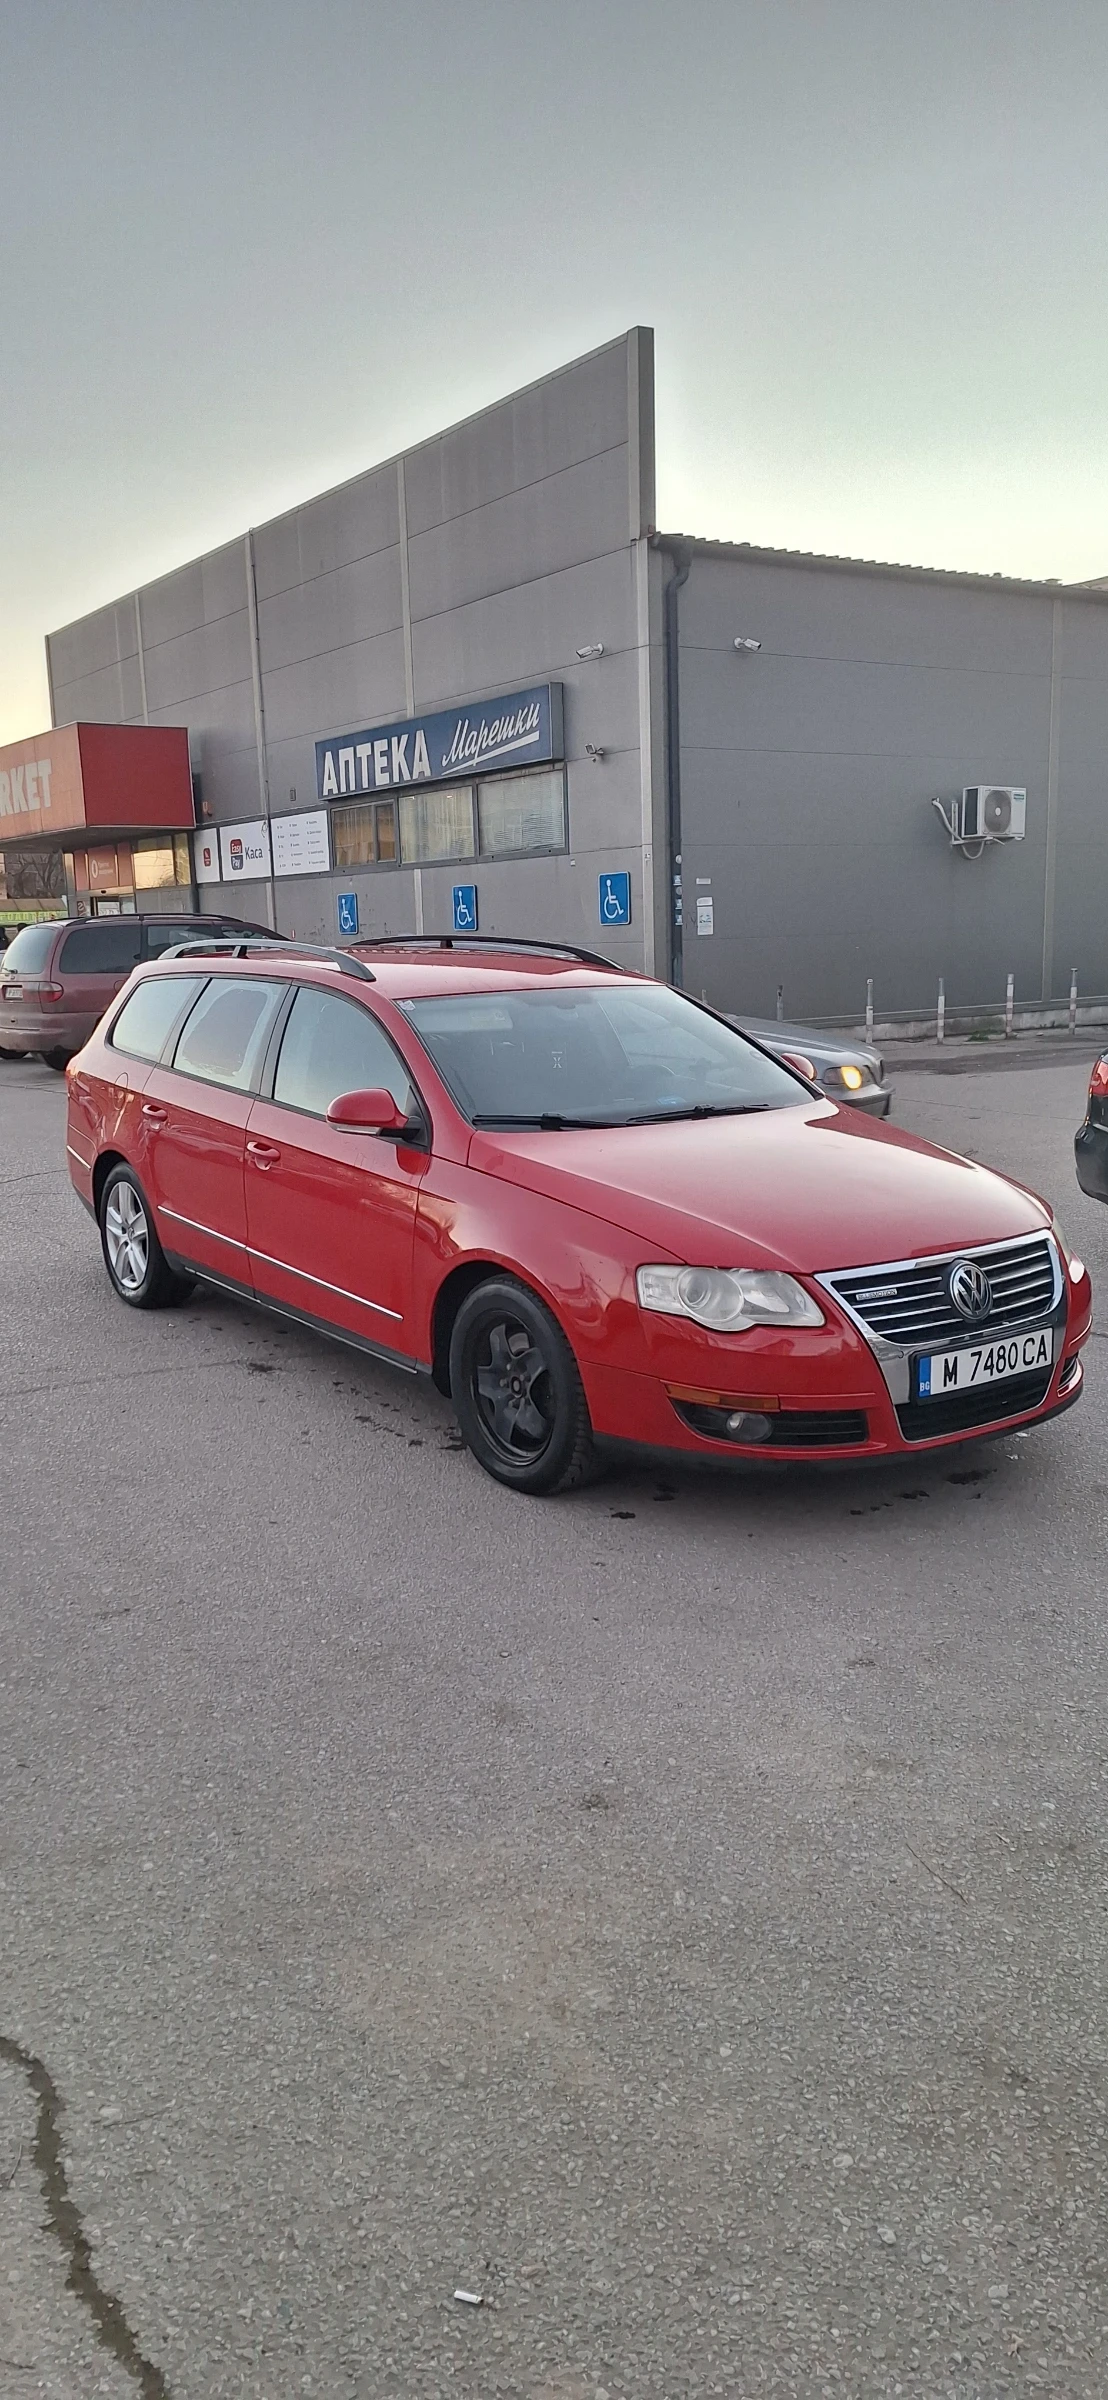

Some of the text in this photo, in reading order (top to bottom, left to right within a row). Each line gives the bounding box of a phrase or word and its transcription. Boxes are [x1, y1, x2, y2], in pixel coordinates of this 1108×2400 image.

[322, 702, 541, 796] АПТЕКА Марешки
[245, 846, 264, 860] Каса
[943, 1334, 1048, 1388] M 7480 CA
[919, 1381, 930, 1392] BG
